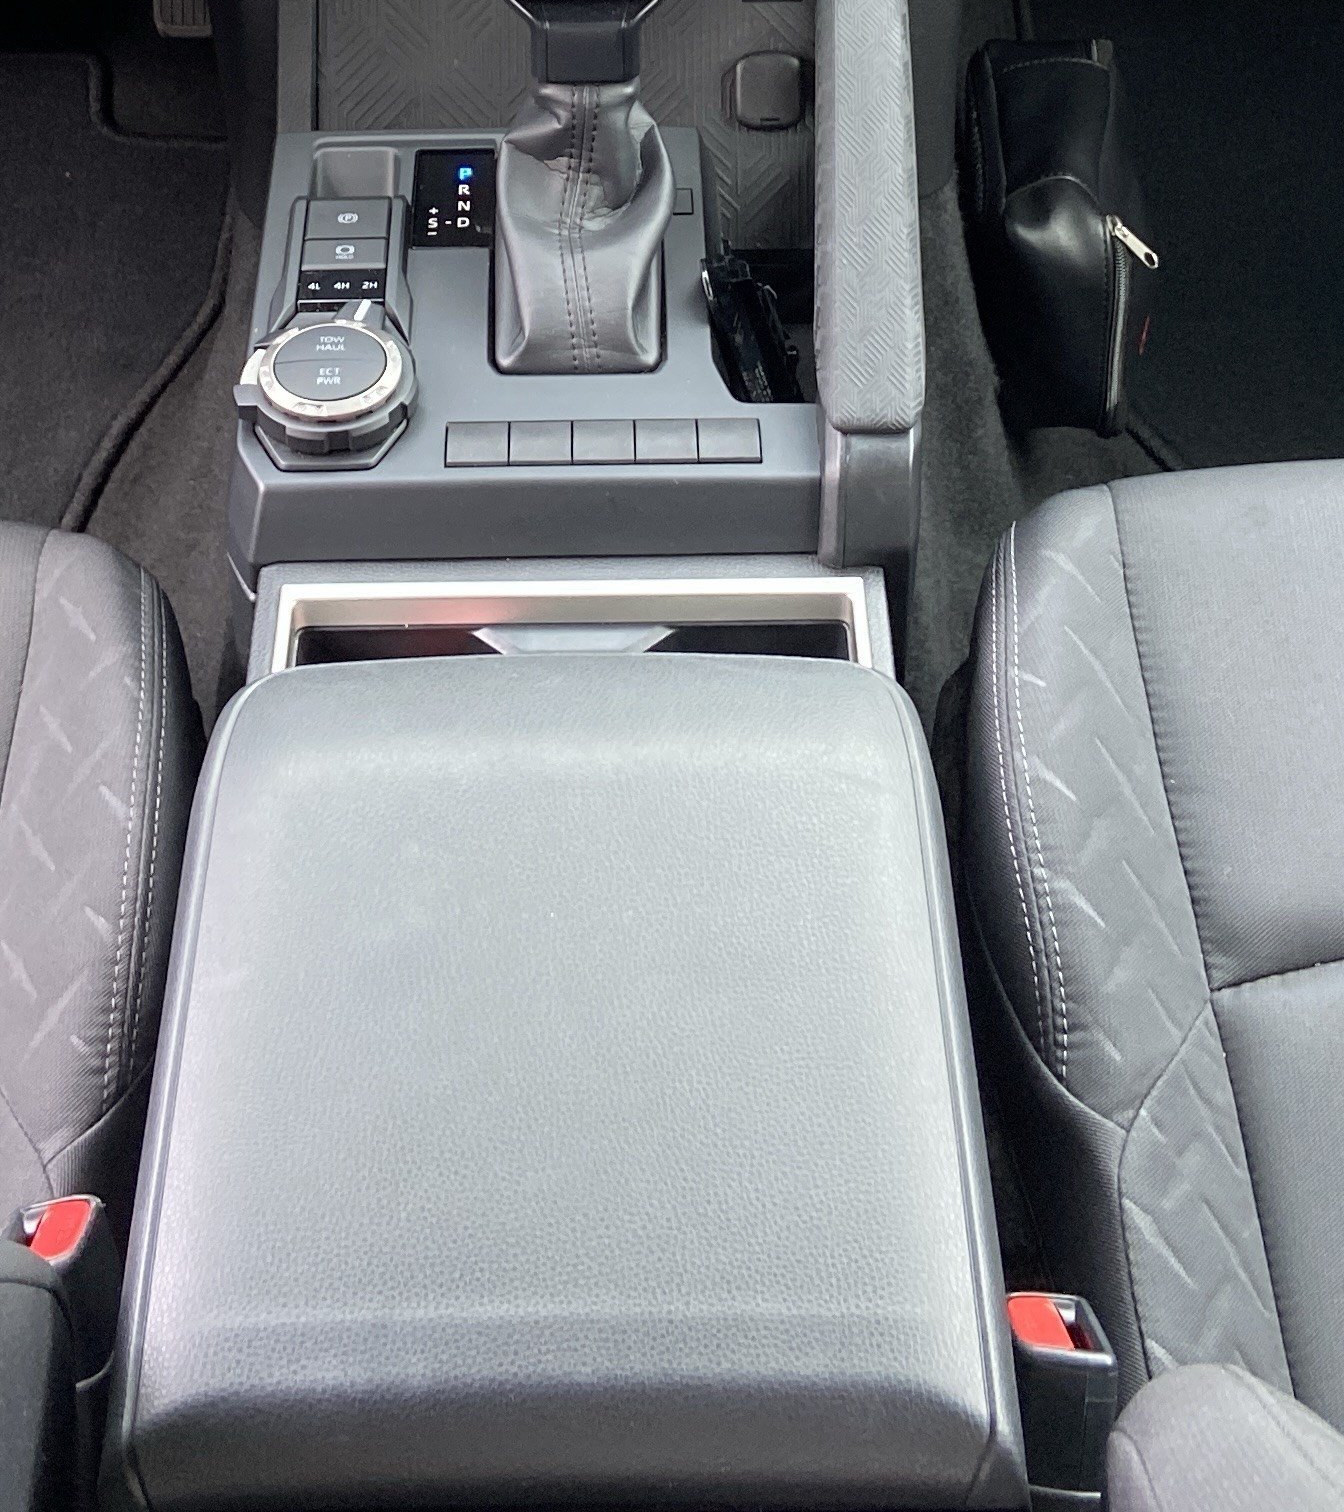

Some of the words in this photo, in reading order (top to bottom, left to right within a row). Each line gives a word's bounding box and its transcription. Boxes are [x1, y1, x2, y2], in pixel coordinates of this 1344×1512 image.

[459, 167, 473, 180] P
[458, 184, 471, 195] R
[457, 200, 471, 211] N
[427, 217, 438, 228] S
[457, 217, 470, 228] D
[307, 282, 321, 290] 4L
[333, 281, 350, 290] 4H
[361, 281, 378, 290] 2H
[319, 367, 340, 376] ECT
[316, 376, 341, 385] PWR
